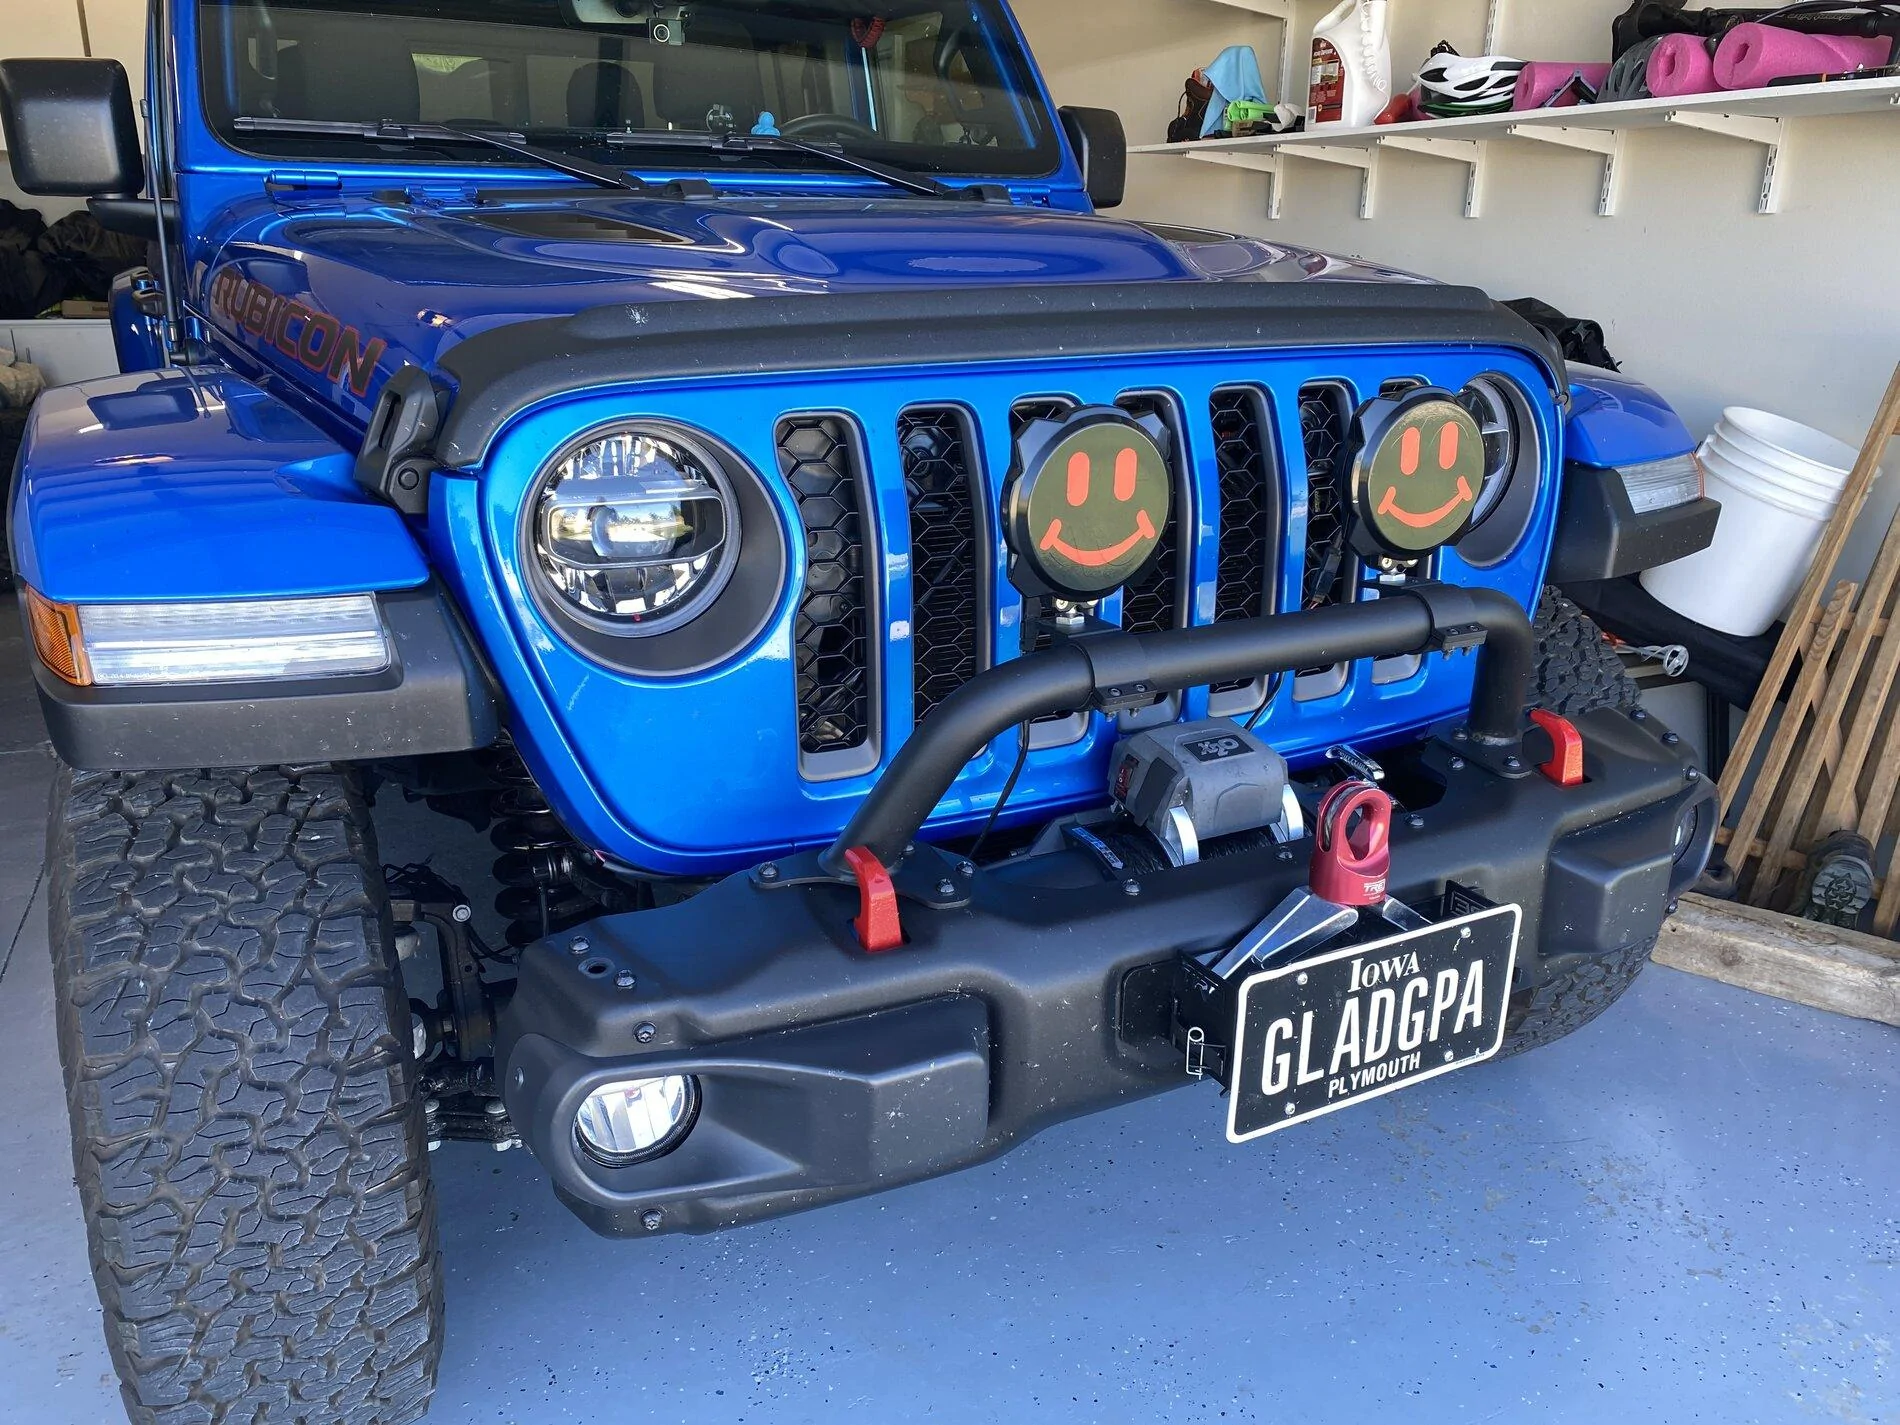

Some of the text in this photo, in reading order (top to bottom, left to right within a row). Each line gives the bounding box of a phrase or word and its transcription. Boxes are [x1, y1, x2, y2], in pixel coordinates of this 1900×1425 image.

[214, 266, 388, 398] RUBICON
[1260, 958, 1485, 1097] GLADGPA
[1327, 1050, 1422, 1099] PLYMOUTH
